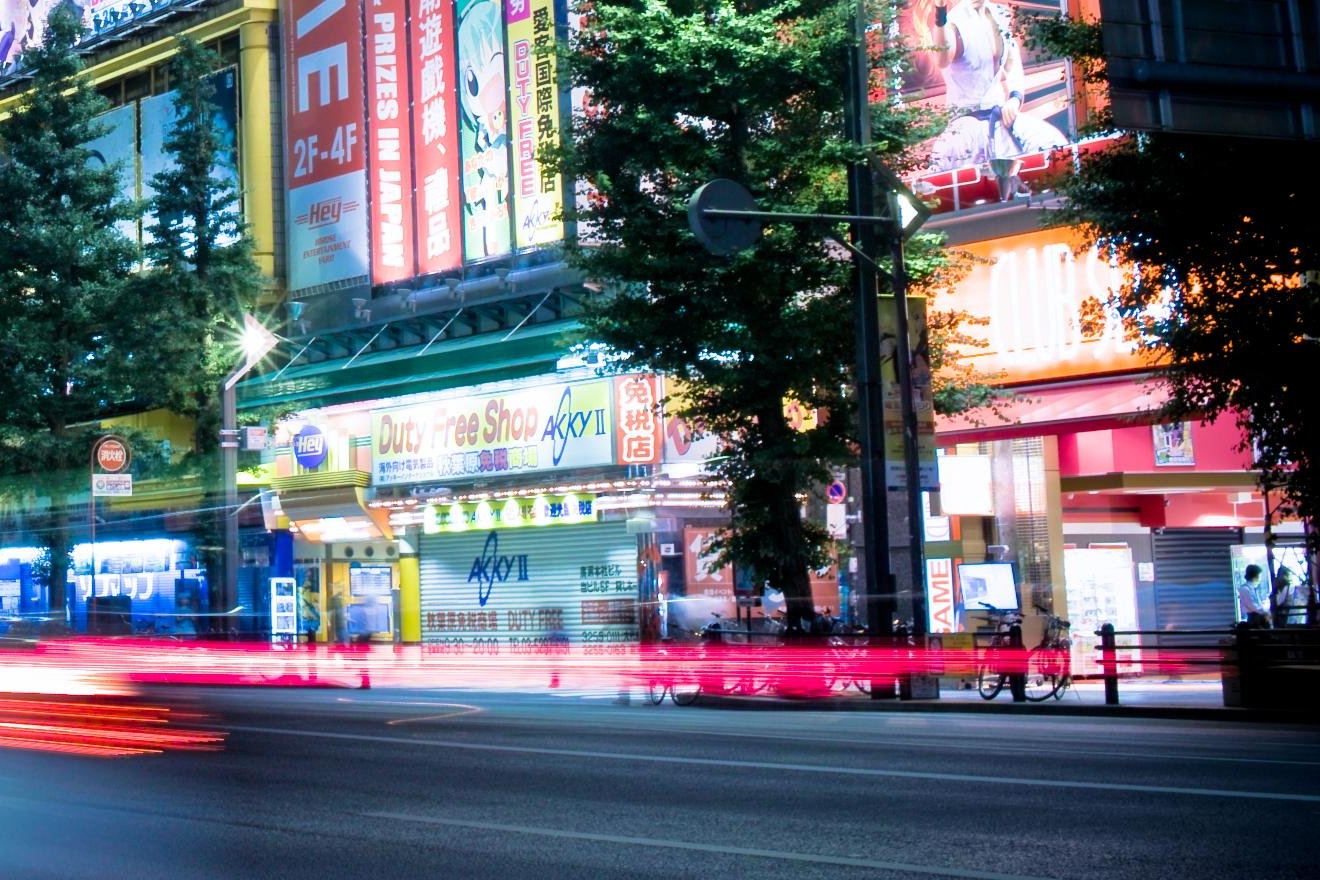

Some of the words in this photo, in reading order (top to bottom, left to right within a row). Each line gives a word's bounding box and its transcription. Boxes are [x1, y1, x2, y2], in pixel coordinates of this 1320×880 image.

[374, 12, 399, 121] PRIZES
[513, 39, 532, 116] DUTY
[294, 123, 357, 178] 2F-4F
[378, 127, 401, 161] IN
[517, 119, 535, 198] FREE
[309, 200, 342, 225] Hey
[379, 168, 405, 268] JAPAN
[297, 435, 324, 456] Hey
[379, 414, 426, 455] Duty
[431, 408, 480, 449] Free
[482, 399, 538, 444] Shop
[542, 386, 592, 466] AKKY
[621, 378, 654, 462] 免税店
[468, 530, 516, 607] AKKY
[508, 610, 536, 631] DUTY
[537, 608, 563, 631] FREE
